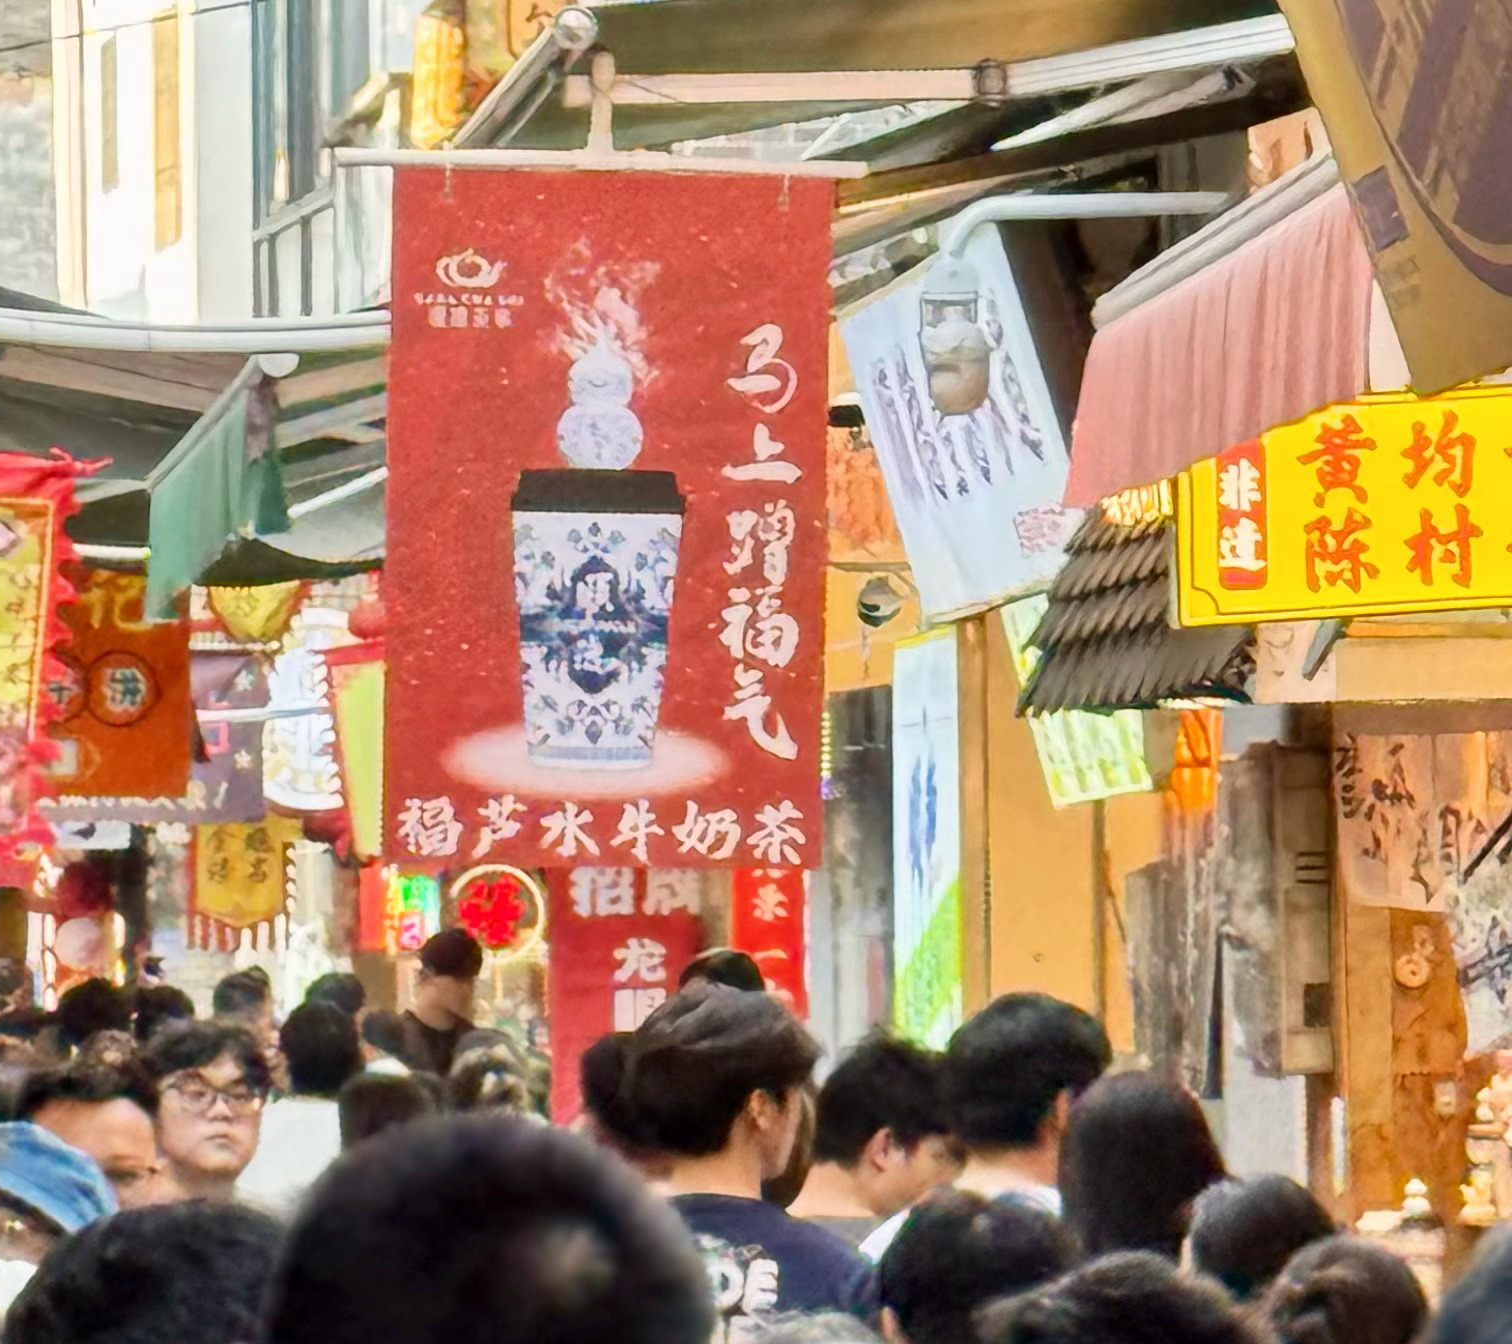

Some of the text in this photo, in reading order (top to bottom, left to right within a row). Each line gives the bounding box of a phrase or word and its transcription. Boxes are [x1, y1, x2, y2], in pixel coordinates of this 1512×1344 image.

[1295, 409, 1512, 508] 黄均
[720, 322, 803, 761] 马上蹭福气
[1303, 502, 1512, 594] 陈村
